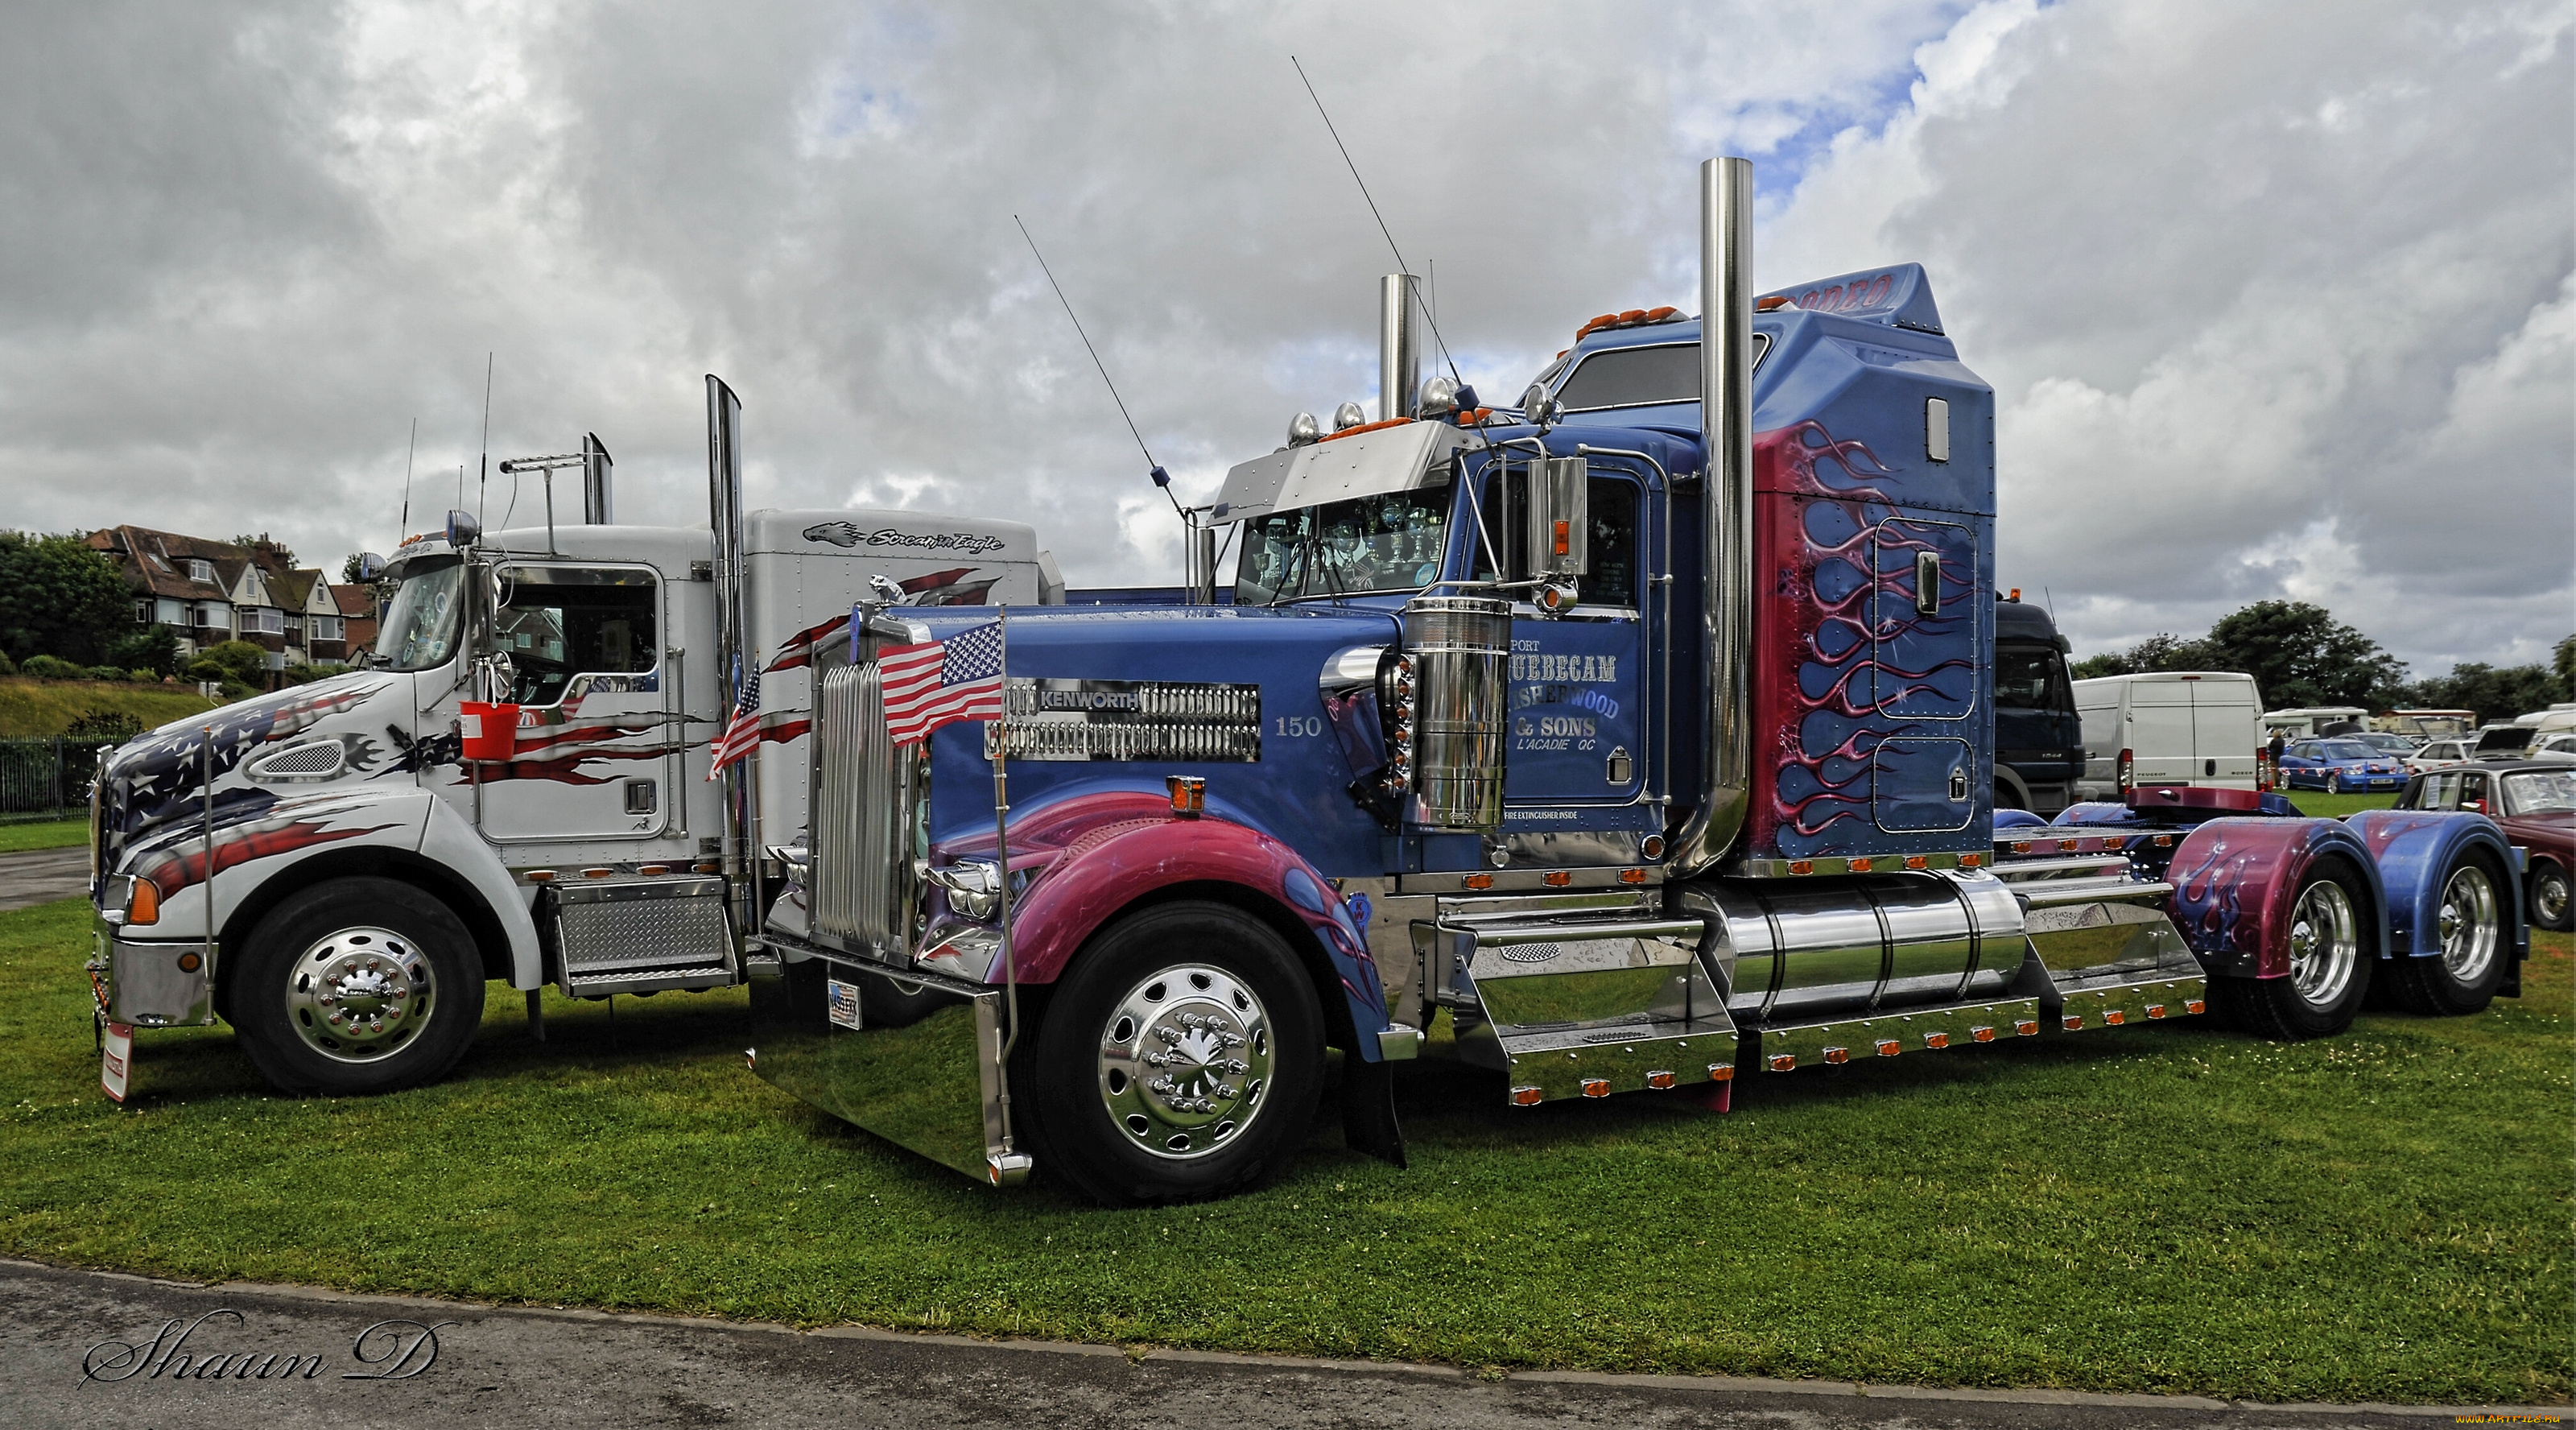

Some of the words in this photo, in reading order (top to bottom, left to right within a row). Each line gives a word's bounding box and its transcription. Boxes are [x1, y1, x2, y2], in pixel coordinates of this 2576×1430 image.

[1509, 654, 1616, 682] UEBECAM
[1041, 692, 1138, 708] KENWORTH
[1276, 716, 1322, 737] 150
[1515, 717, 1534, 736] &
[1541, 717, 1596, 737] SONS
[1517, 738, 1570, 750] L'ACADIE
[1578, 738, 1596, 750] QC
[1505, 811, 1517, 820] FIRE
[1517, 811, 1558, 820] EXTINGUISHER
[1558, 811, 1577, 820] INSIDE
